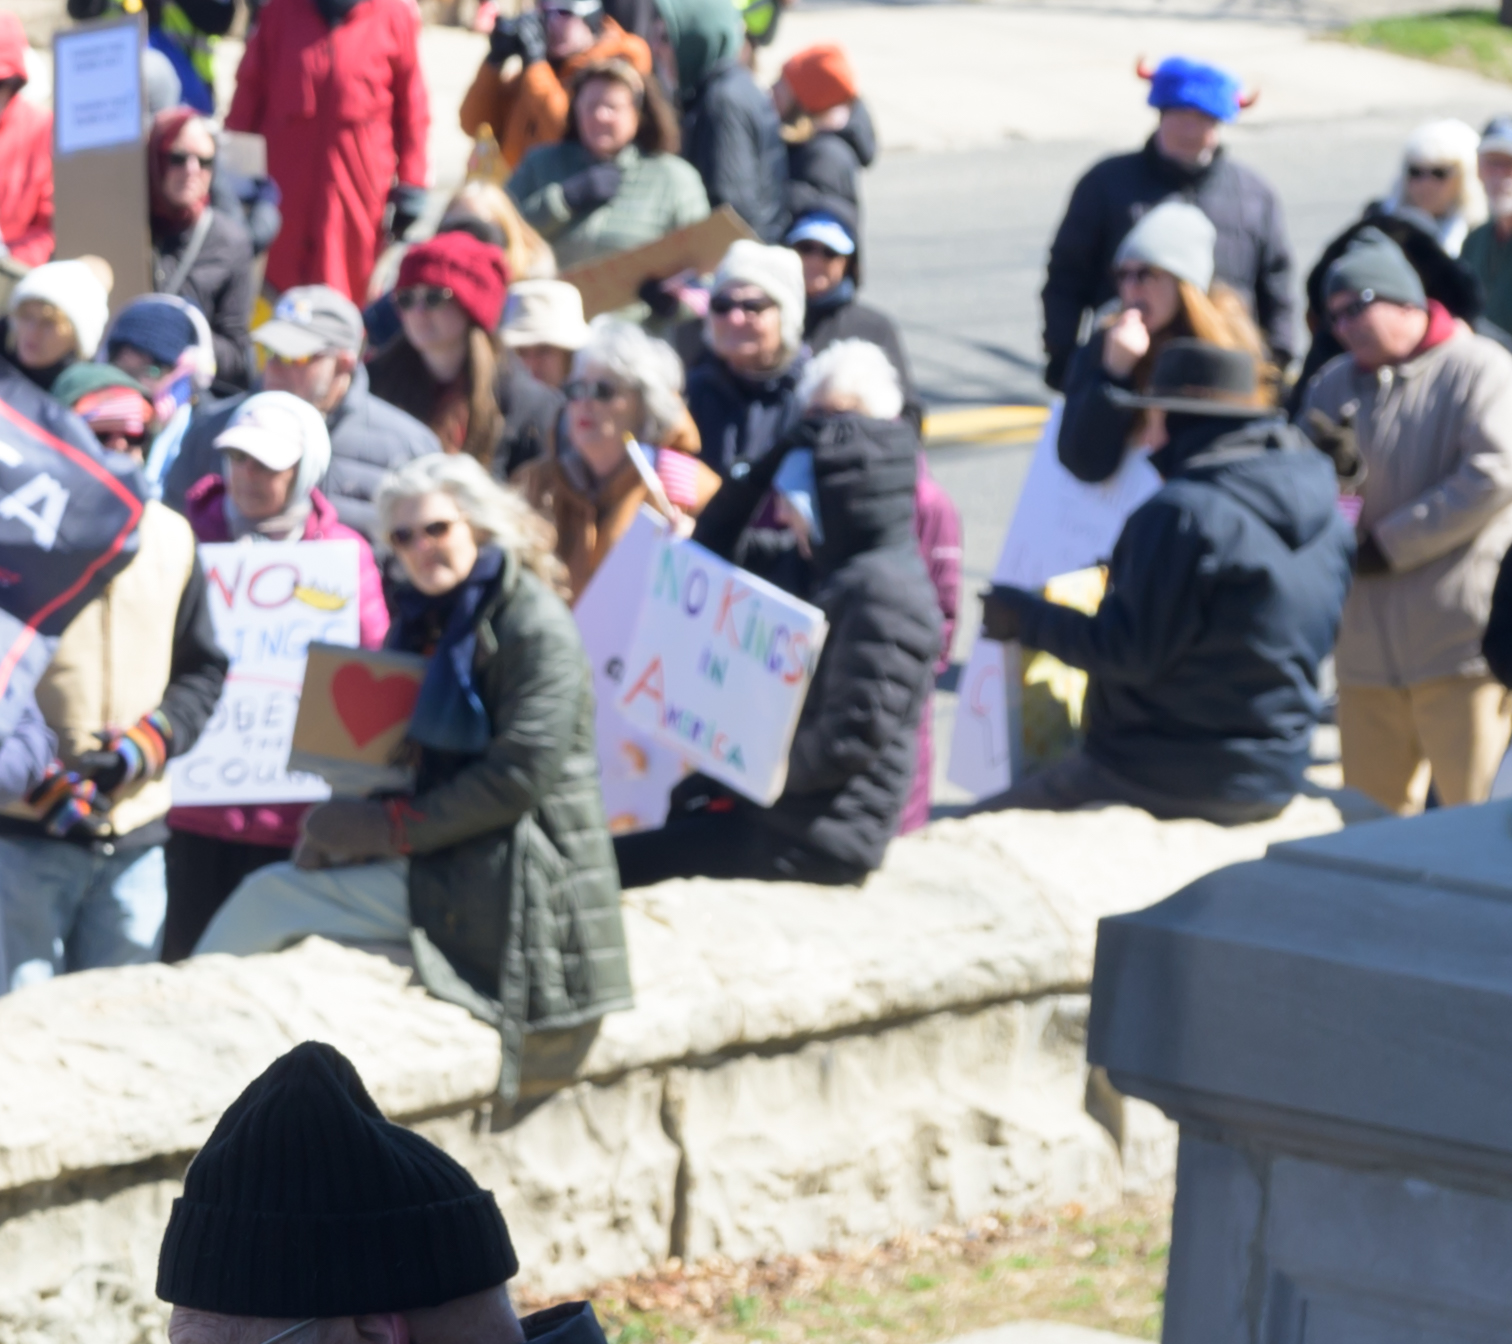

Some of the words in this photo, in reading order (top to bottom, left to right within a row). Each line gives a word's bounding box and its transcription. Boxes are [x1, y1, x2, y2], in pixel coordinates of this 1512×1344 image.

[206, 555, 300, 612] NO
[653, 546, 708, 620] NO
[714, 574, 807, 687] KINGS
